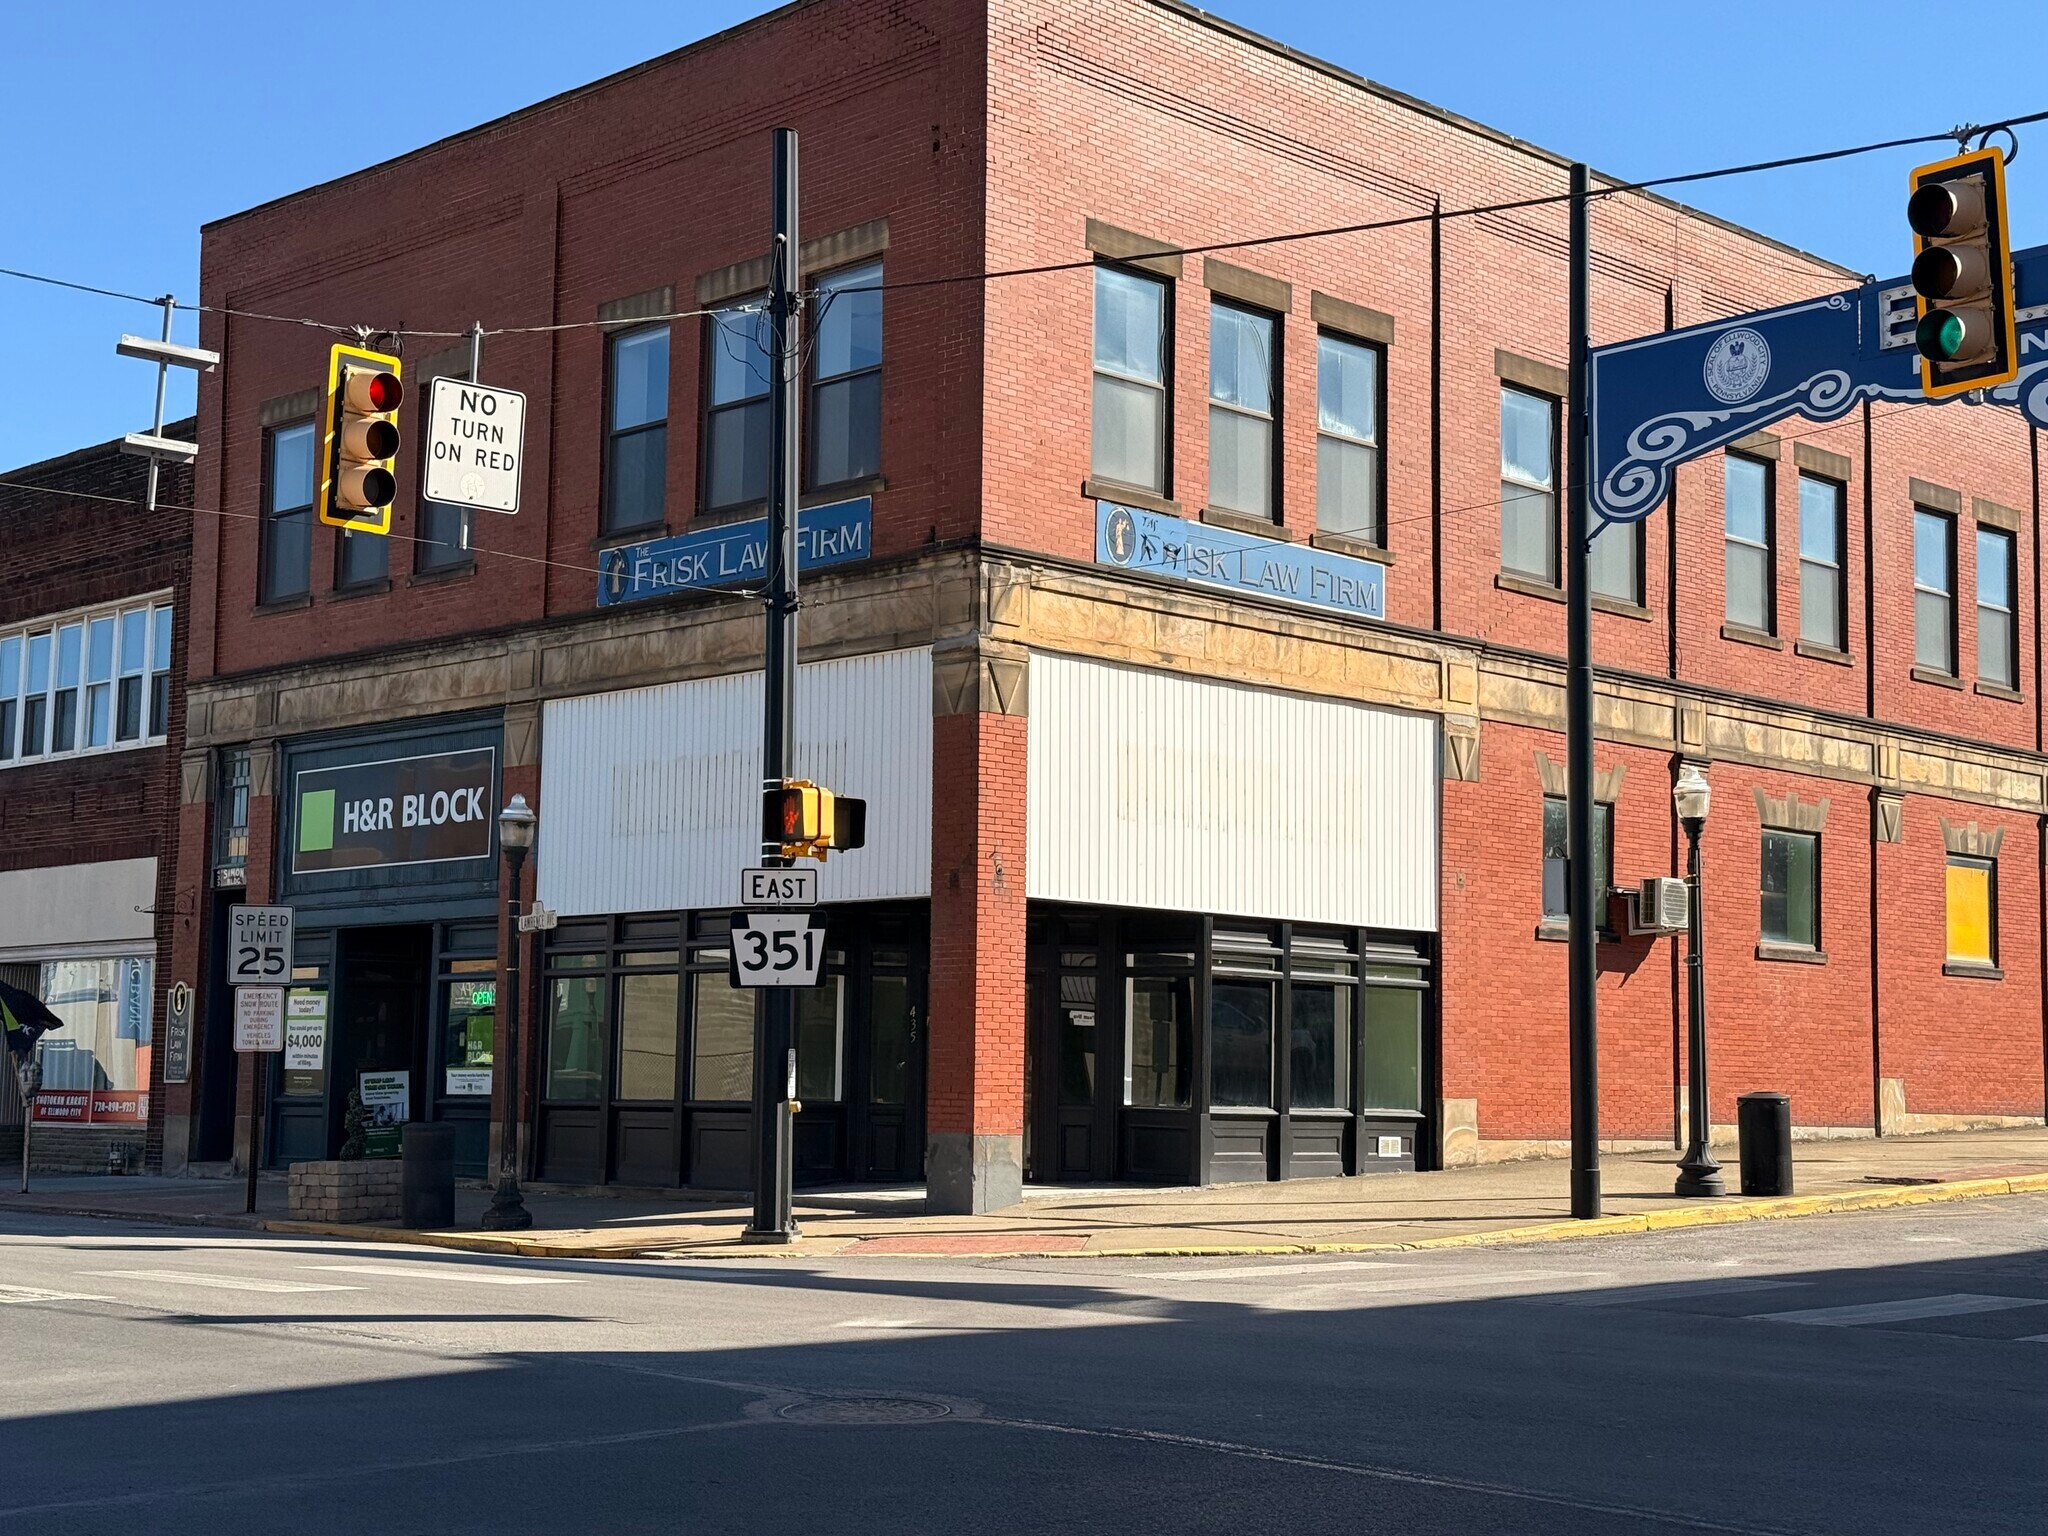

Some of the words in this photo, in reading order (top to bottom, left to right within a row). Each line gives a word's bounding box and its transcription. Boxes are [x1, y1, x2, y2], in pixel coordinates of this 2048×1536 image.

[1708, 354, 1717, 377] SEAL
[1714, 341, 1725, 353] OF
[1723, 332, 1761, 346] ELLWOOD
[1758, 345, 1767, 365] CITY
[1712, 376, 1762, 399] PENNSYLVANIA
[460, 389, 497, 416] NO
[451, 417, 504, 444] TURN
[434, 441, 462, 463] ON
[475, 448, 515, 471] RED
[635, 546, 650, 559] THE
[633, 551, 710, 592] FRISK
[1239, 550, 1300, 595] LAW
[1310, 564, 1377, 612] FIRM
[343, 797, 394, 834] H&R
[401, 786, 486, 829] BLOCK
[752, 875, 806, 899] EAST
[235, 914, 289, 926] SPEED
[241, 930, 282, 943] LIMIT
[237, 946, 286, 975] 25
[742, 930, 814, 972] 351
[240, 1000, 257, 1008] SNOW
[259, 1000, 279, 1008] ROUTE
[243, 992, 278, 1000] EMERGENCY
[472, 991, 493, 1005] OPEN
[909, 1005, 917, 1044] 435
[287, 1033, 323, 1050] $4,000
[467, 1040, 483, 1050] H&R
[36, 1095, 65, 1105] SHOTOKAN
[65, 1095, 88, 1106] KARATE
[47, 1107, 69, 1116] ELLWOOD
[69, 1108, 82, 1117] CITY
